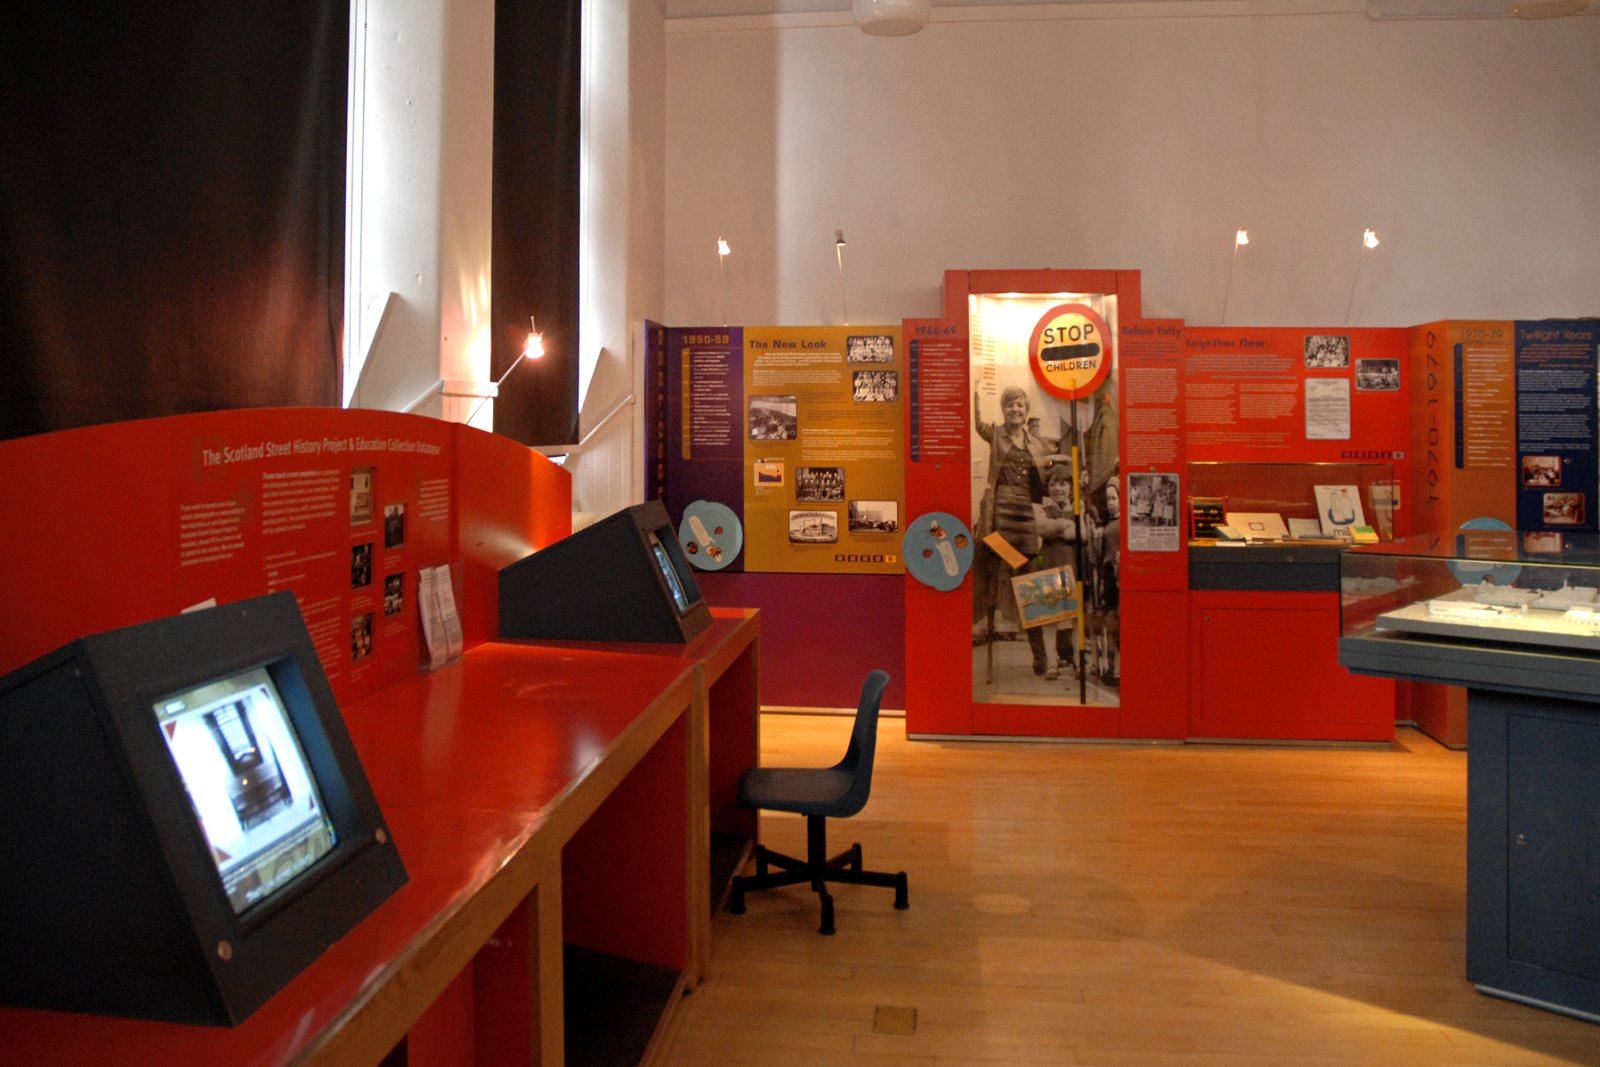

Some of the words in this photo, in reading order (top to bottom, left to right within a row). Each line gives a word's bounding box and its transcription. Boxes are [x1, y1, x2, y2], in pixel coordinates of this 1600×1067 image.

[1044, 323, 1094, 344] STOP
[749, 340, 769, 349] The
[773, 340, 797, 348] New
[801, 340, 827, 349] Look
[1046, 360, 1097, 373] CHILDREN
[203, 449, 221, 466] The
[223, 442, 264, 463] Scotland
[266, 441, 292, 457] Street
[293, 438, 321, 456] History
[322, 437, 347, 454] Project
[355, 437, 387, 451] Education
[1333, 526, 1351, 536] mil
